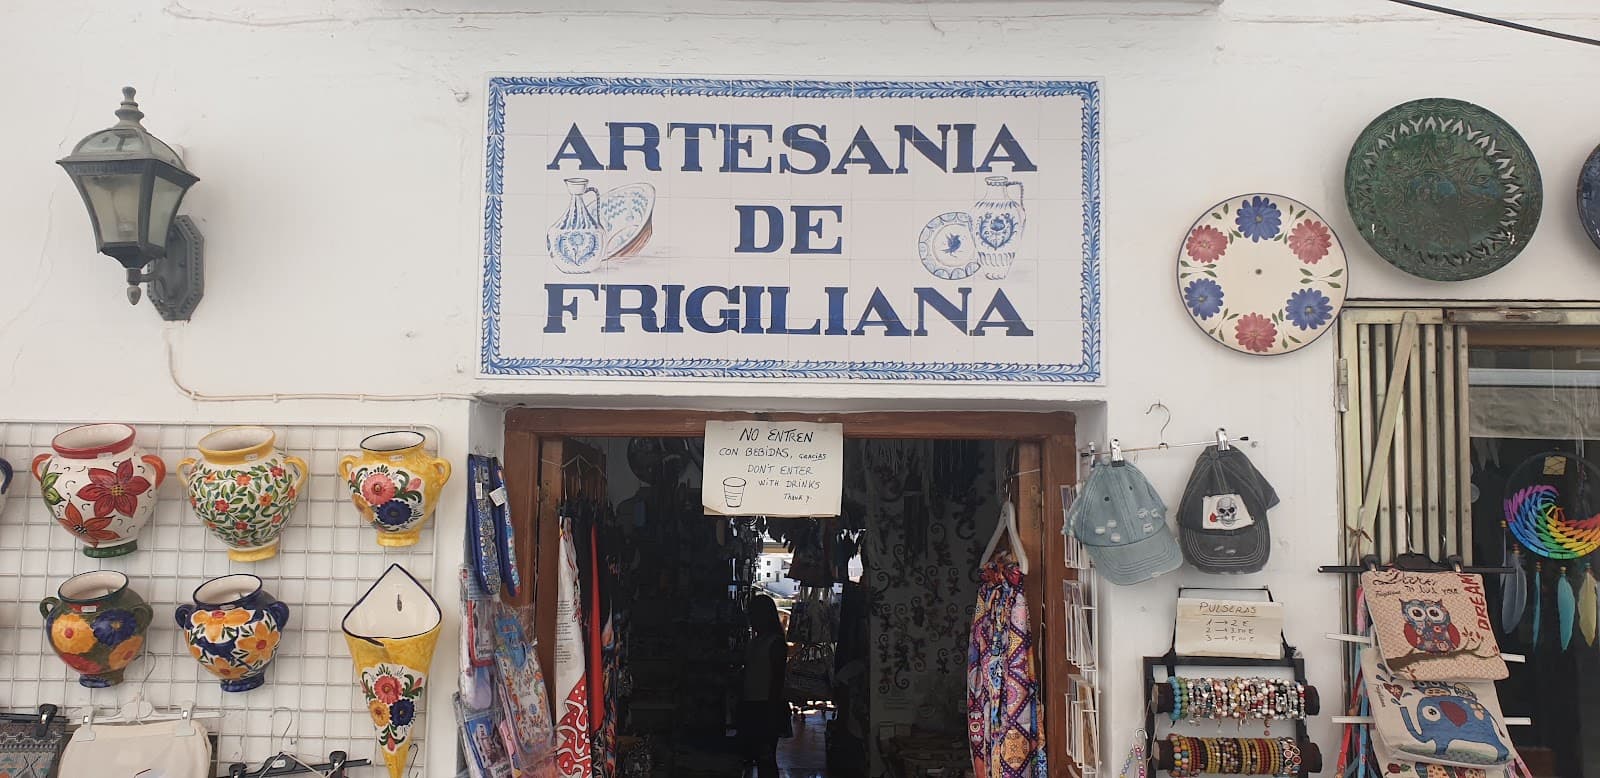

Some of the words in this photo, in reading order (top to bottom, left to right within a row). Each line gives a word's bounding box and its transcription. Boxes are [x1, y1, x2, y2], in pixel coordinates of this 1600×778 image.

[546, 121, 1038, 175] ARTESANIA
[734, 204, 843, 255] DE
[543, 283, 1034, 337] FRIGILIANA
[738, 427, 760, 441] NO
[767, 428, 814, 443] ENTREN
[719, 447, 739, 456] CON
[747, 463, 775, 473] DON'T
[780, 465, 814, 475] ENTER
[1199, 601, 1257, 614] PULSERAS
